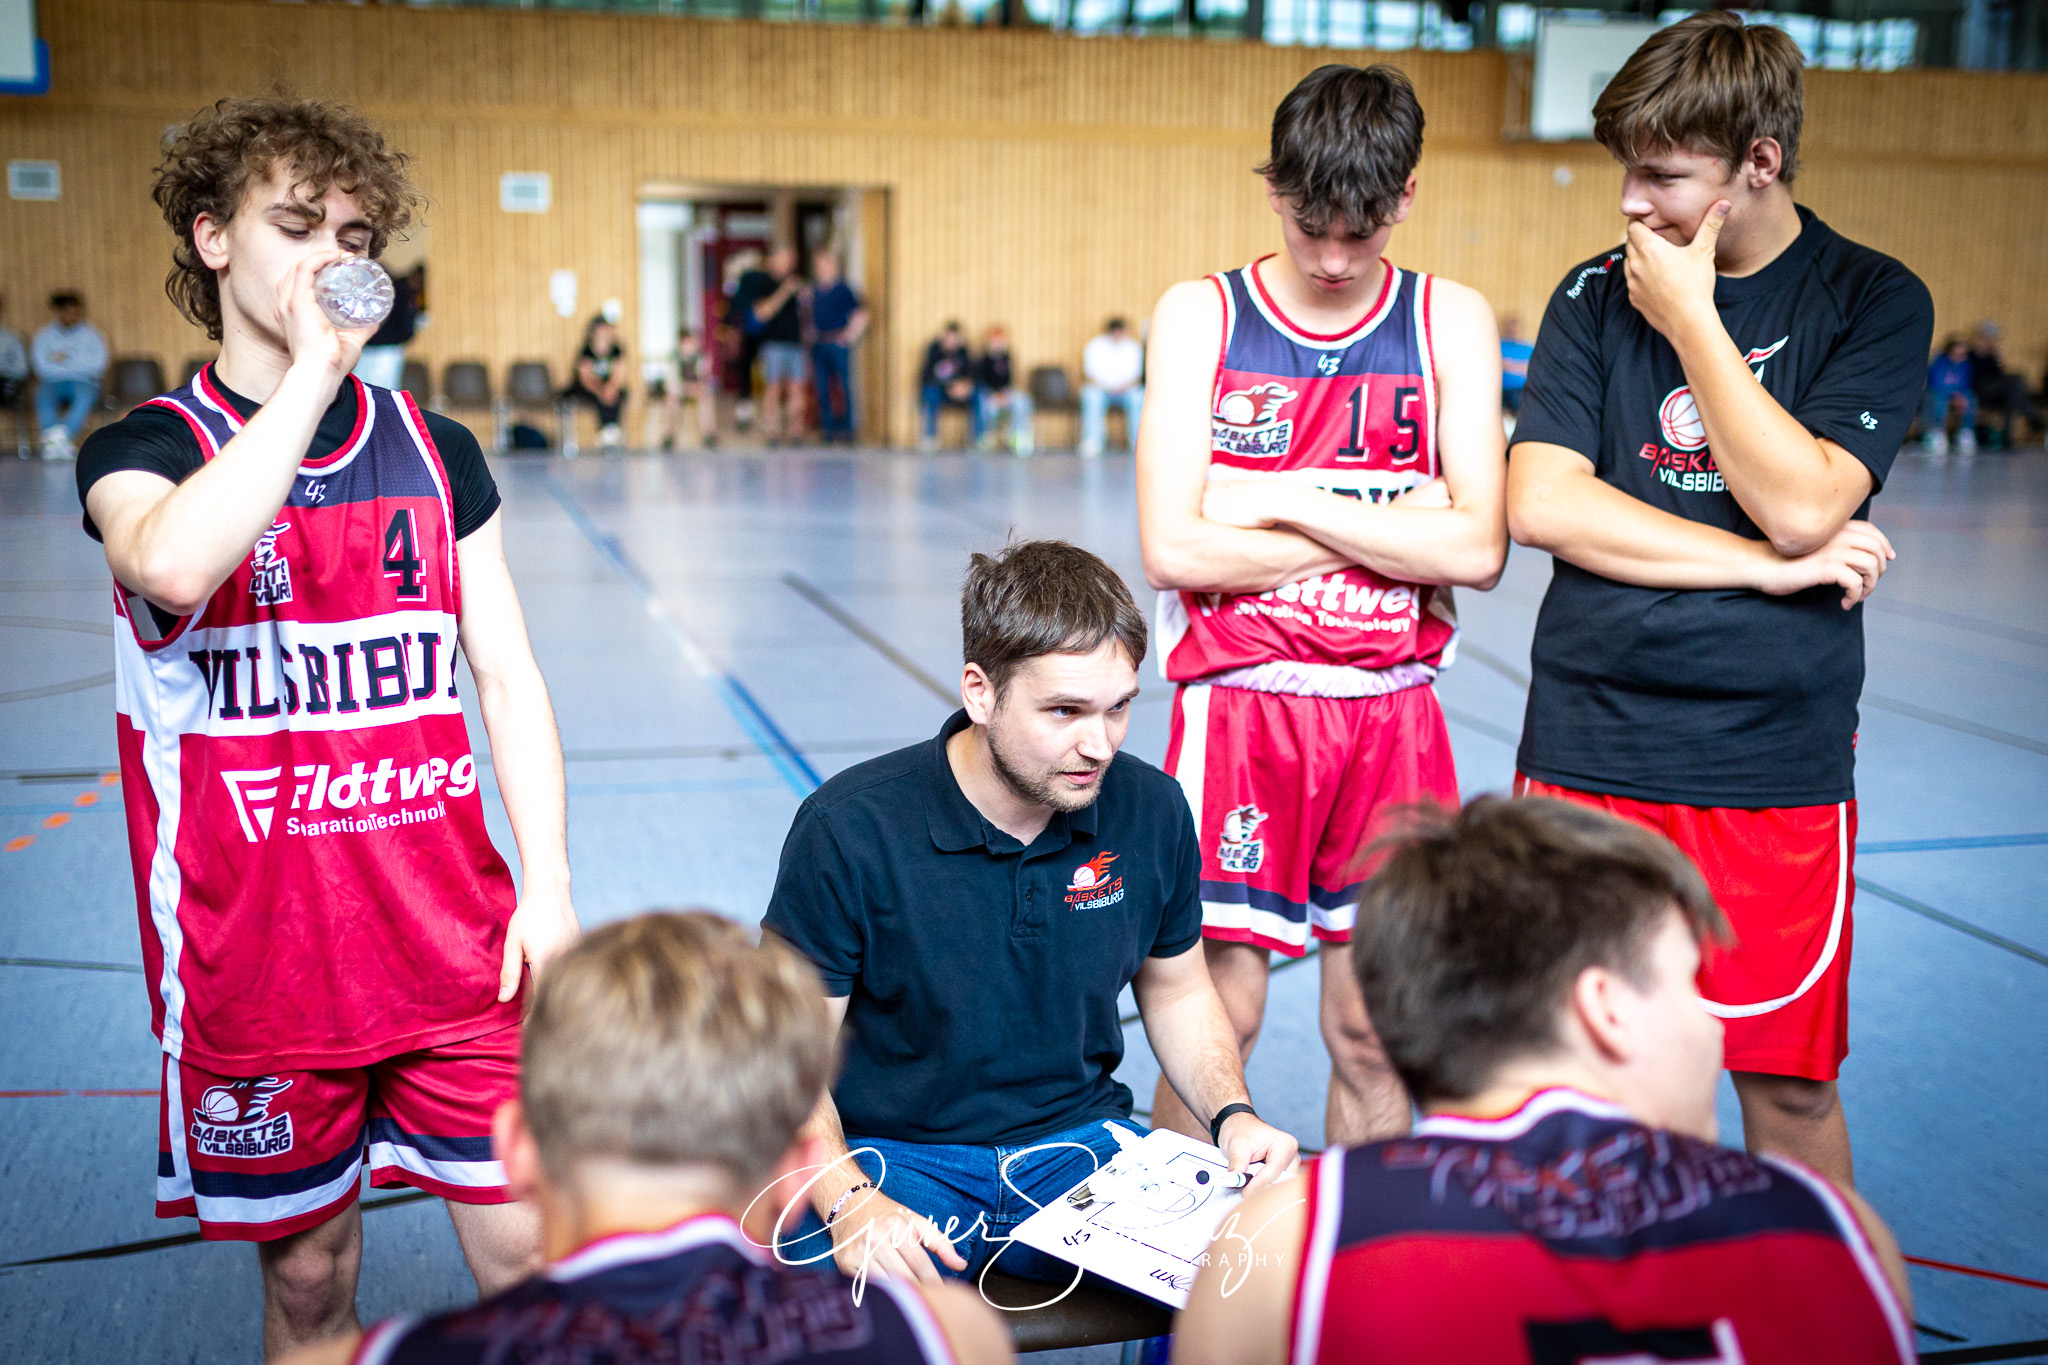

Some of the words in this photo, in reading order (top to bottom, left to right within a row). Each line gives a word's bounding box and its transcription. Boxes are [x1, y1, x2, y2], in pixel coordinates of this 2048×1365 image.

[382, 507, 427, 602] 4
[1063, 876, 1123, 912] BASKETS
[1074, 888, 1125, 911] VILSBIBURG
[191, 1114, 288, 1151] BASKETS
[203, 1132, 291, 1157] VILSBIBURG
